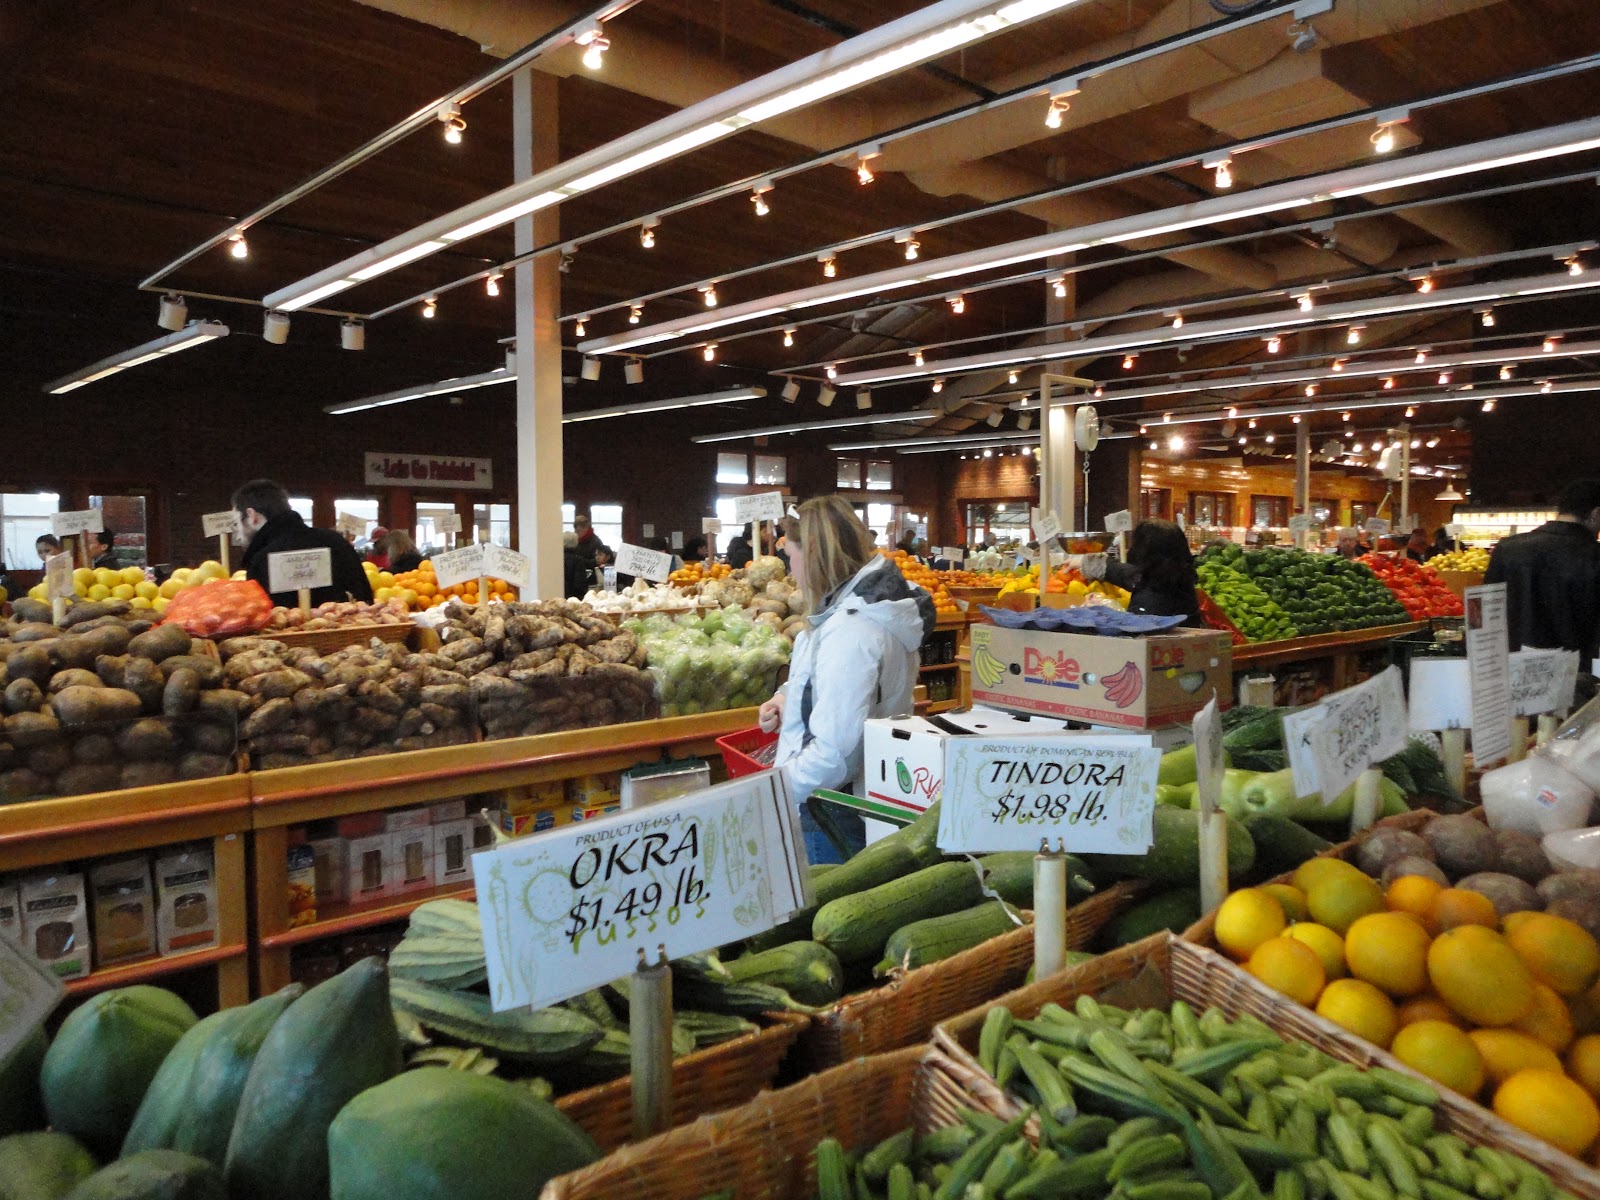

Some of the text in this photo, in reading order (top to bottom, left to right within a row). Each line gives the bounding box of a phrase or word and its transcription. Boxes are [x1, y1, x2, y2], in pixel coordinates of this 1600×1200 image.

[1024, 647, 1080, 682] Dole
[981, 744, 1025, 754] PRODUCT
[990, 760, 1125, 787] TINDORA
[991, 788, 1107, 823] $1.98 lb.
[575, 824, 633, 847] PRODUCT
[635, 820, 651, 832] OF
[569, 822, 698, 890] OKRA
[565, 864, 711, 944] $1.49 lb.
